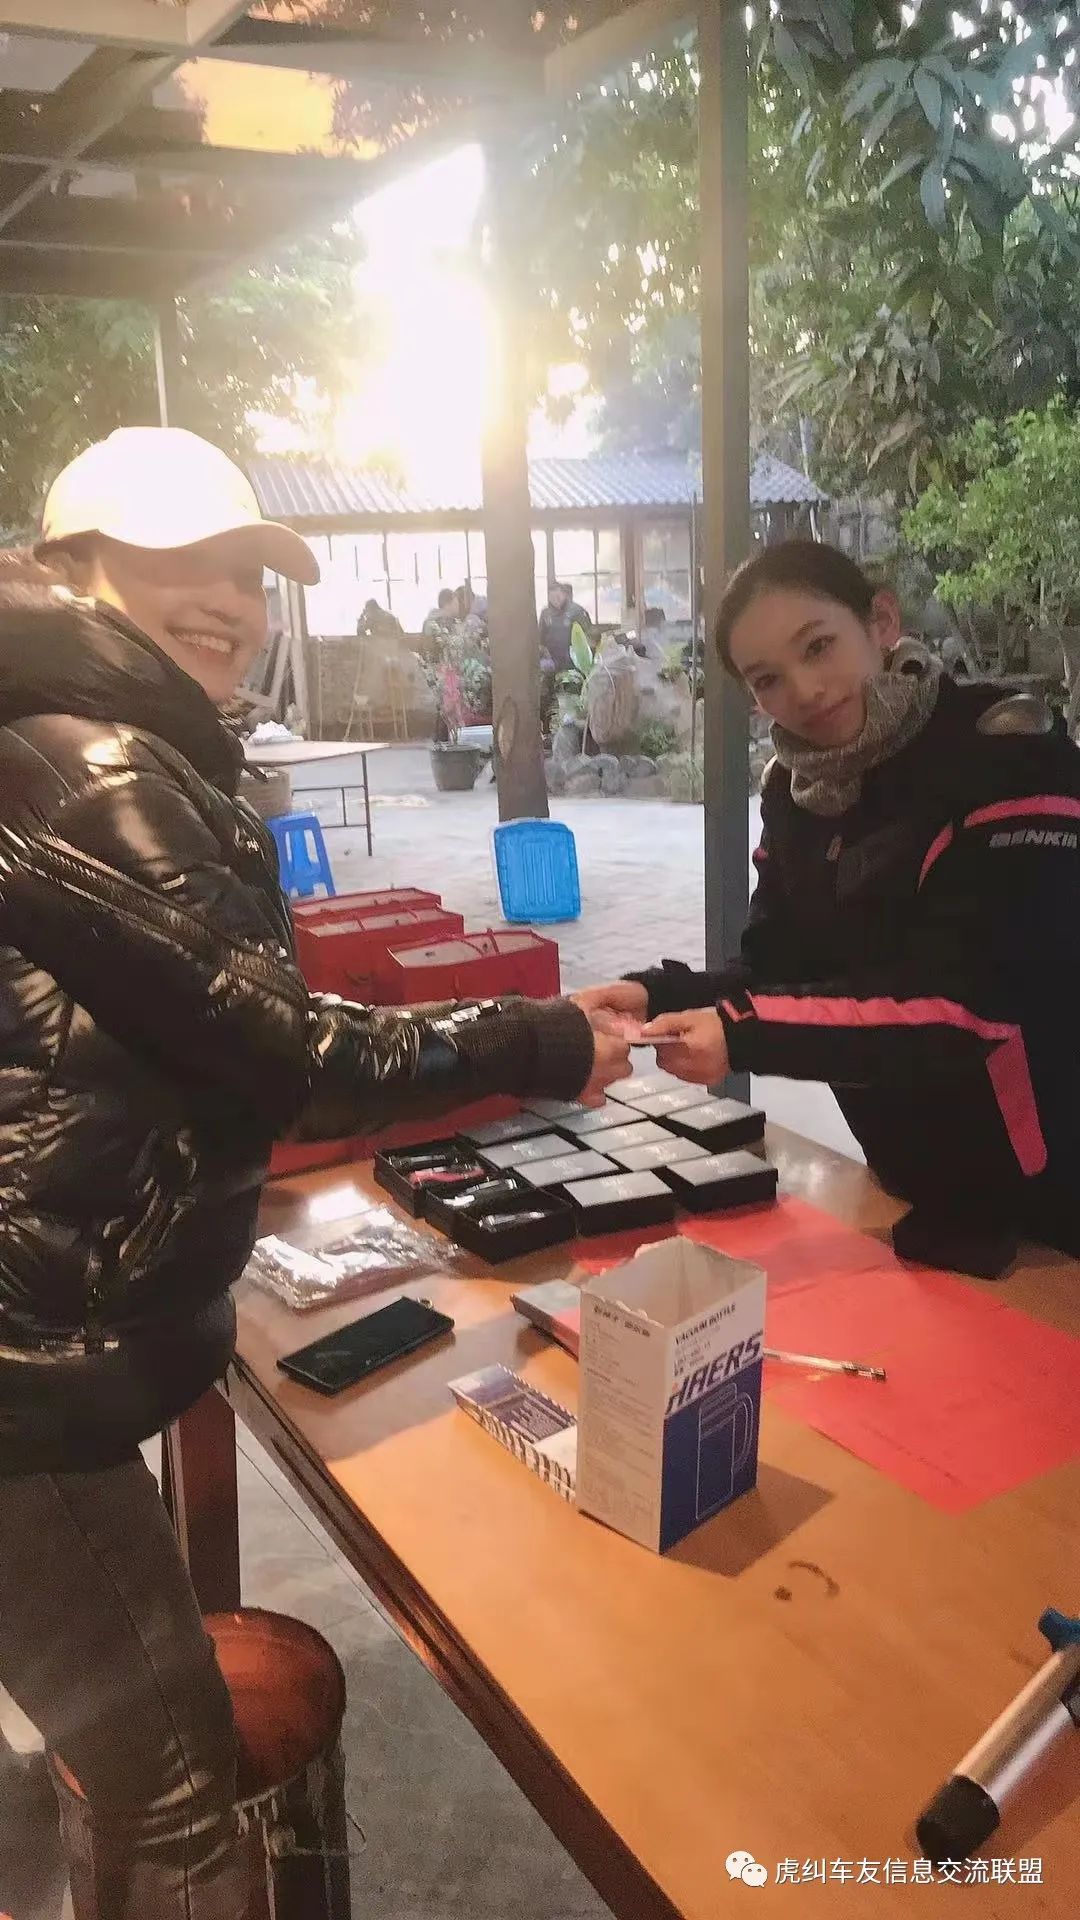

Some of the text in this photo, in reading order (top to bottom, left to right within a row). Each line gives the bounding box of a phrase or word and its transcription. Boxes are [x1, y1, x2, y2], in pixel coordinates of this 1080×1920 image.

[674, 1319, 707, 1345] VACUUM
[709, 1301, 736, 1325] BOTTLE
[665, 1329, 764, 1415] HAERS
